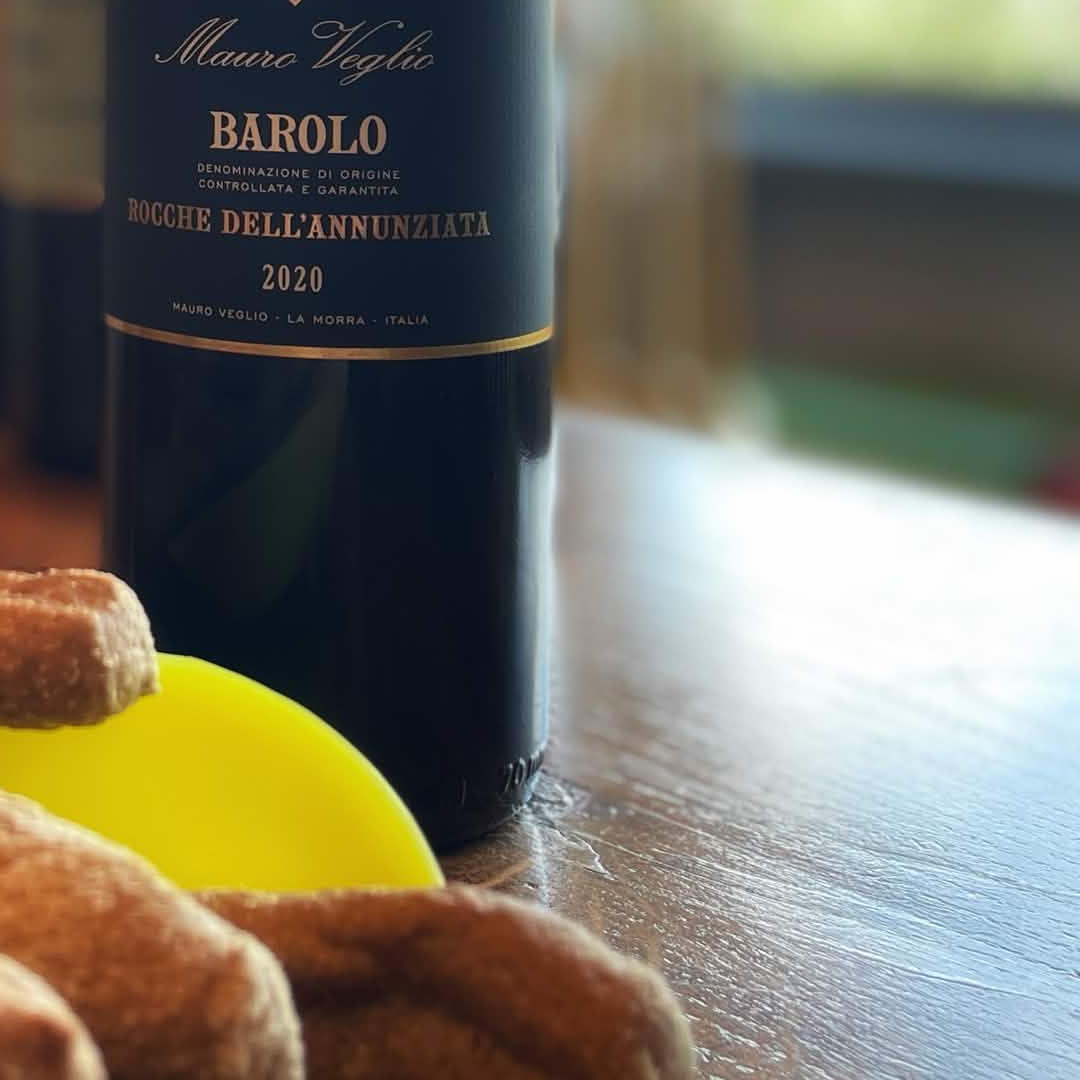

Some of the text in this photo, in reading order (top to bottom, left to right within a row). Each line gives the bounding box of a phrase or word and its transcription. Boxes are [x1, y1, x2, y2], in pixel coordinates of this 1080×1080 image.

[154, 17, 435, 87] Mauro Veglio
[209, 110, 387, 154] BAROLO
[197, 163, 401, 180] DENOMINAZIONE DI ORIGINE
[199, 179, 399, 196] CONTROLLATA E GARANTITA
[127, 198, 212, 232] ROCCHE
[261, 263, 323, 293] 2020
[172, 302, 213, 317] MAURO
[219, 307, 268, 322] VEGLIO
[287, 313, 305, 325] LA
[313, 315, 366, 326] MORRA
[385, 315, 429, 326] ITALIA
